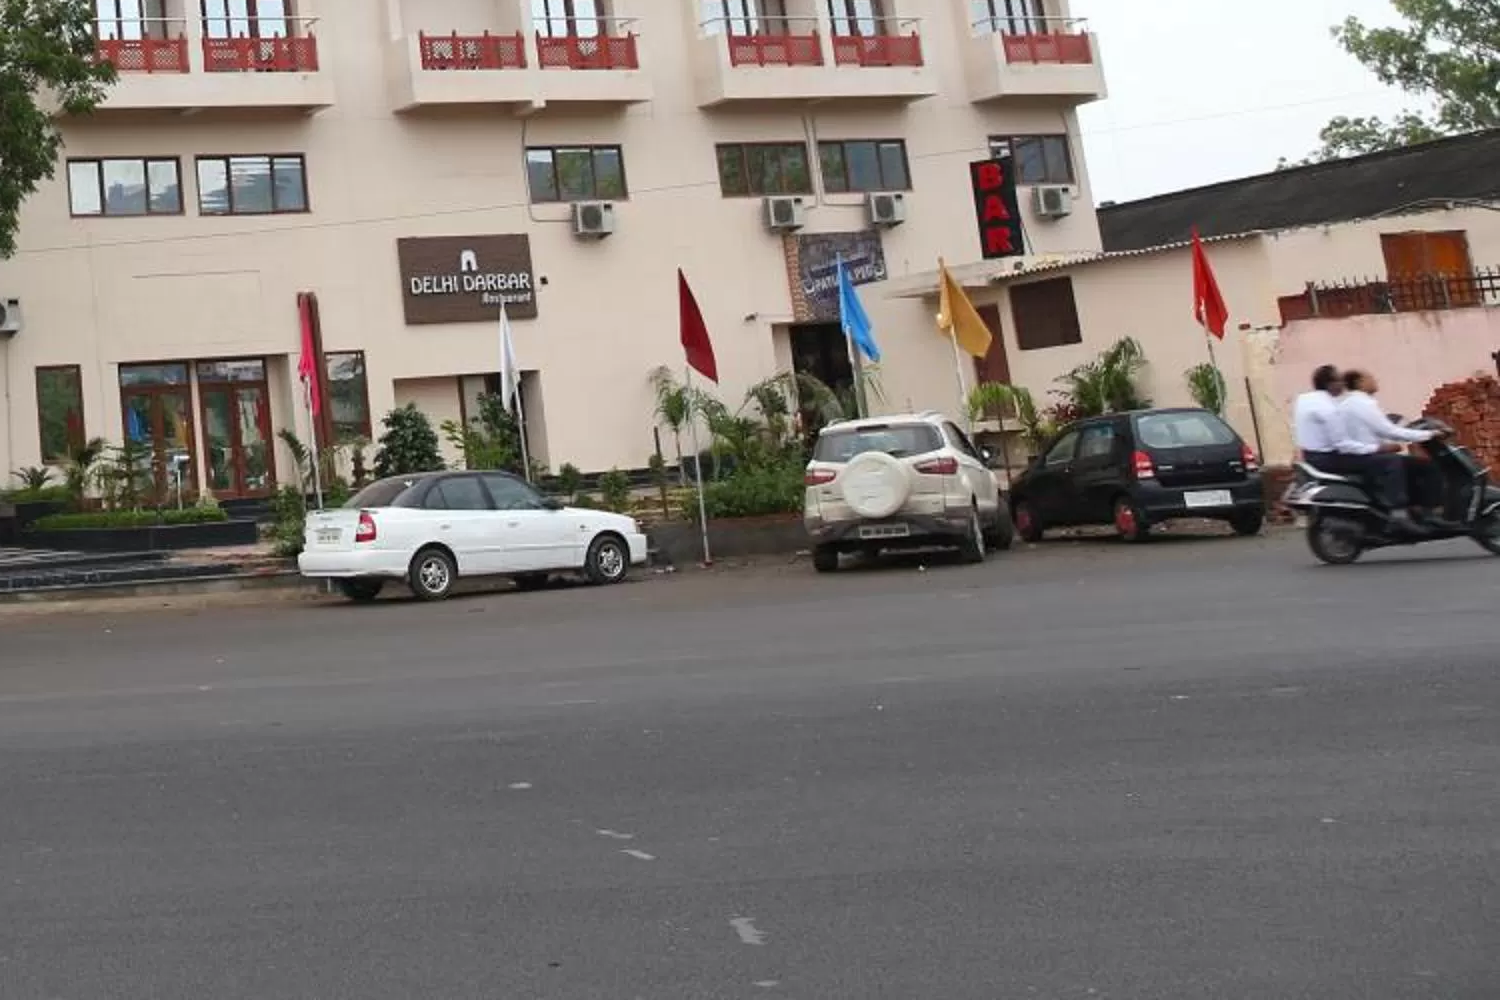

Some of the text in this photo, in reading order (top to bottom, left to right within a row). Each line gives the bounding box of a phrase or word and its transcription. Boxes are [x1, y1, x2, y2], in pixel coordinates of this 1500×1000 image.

[977, 162, 1013, 254] BAR
[411, 271, 531, 294] DELHI DARBAR
